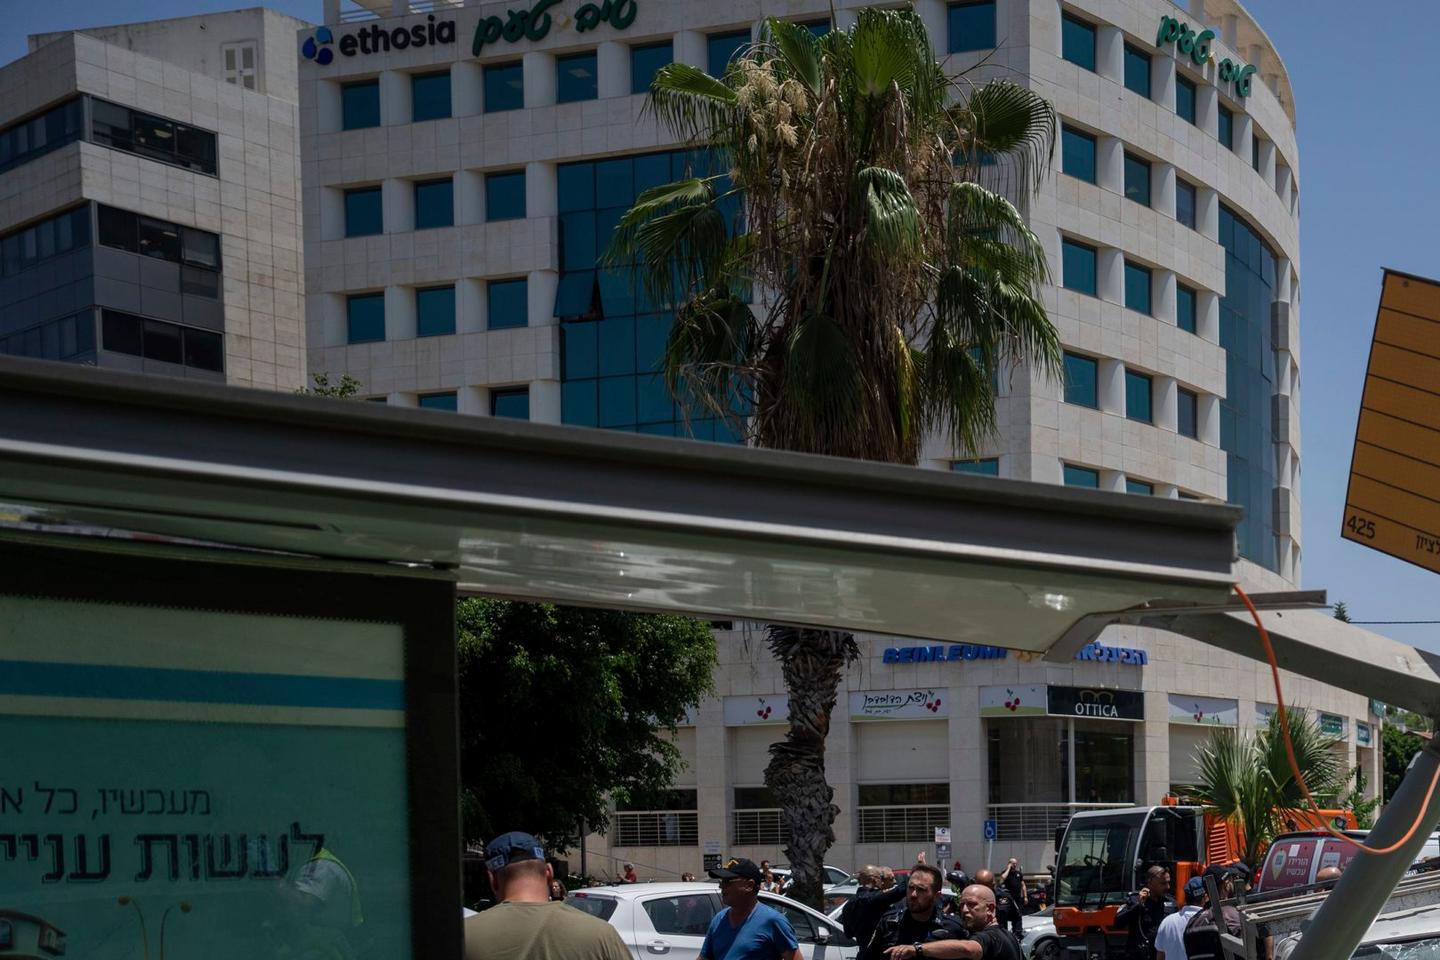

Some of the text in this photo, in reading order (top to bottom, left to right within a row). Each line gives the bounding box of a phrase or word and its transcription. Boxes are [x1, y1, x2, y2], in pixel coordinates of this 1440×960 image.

[340, 14, 456, 58] ethosia
[1346, 515, 1376, 540] 425
[882, 644, 1008, 665] BEINLEUMI
[1075, 702, 1118, 718] OTTICA
[33, 781, 79, 815] כל
[90, 787, 212, 821] מעכשיו,
[0, 821, 326, 885] לעשות עניי
